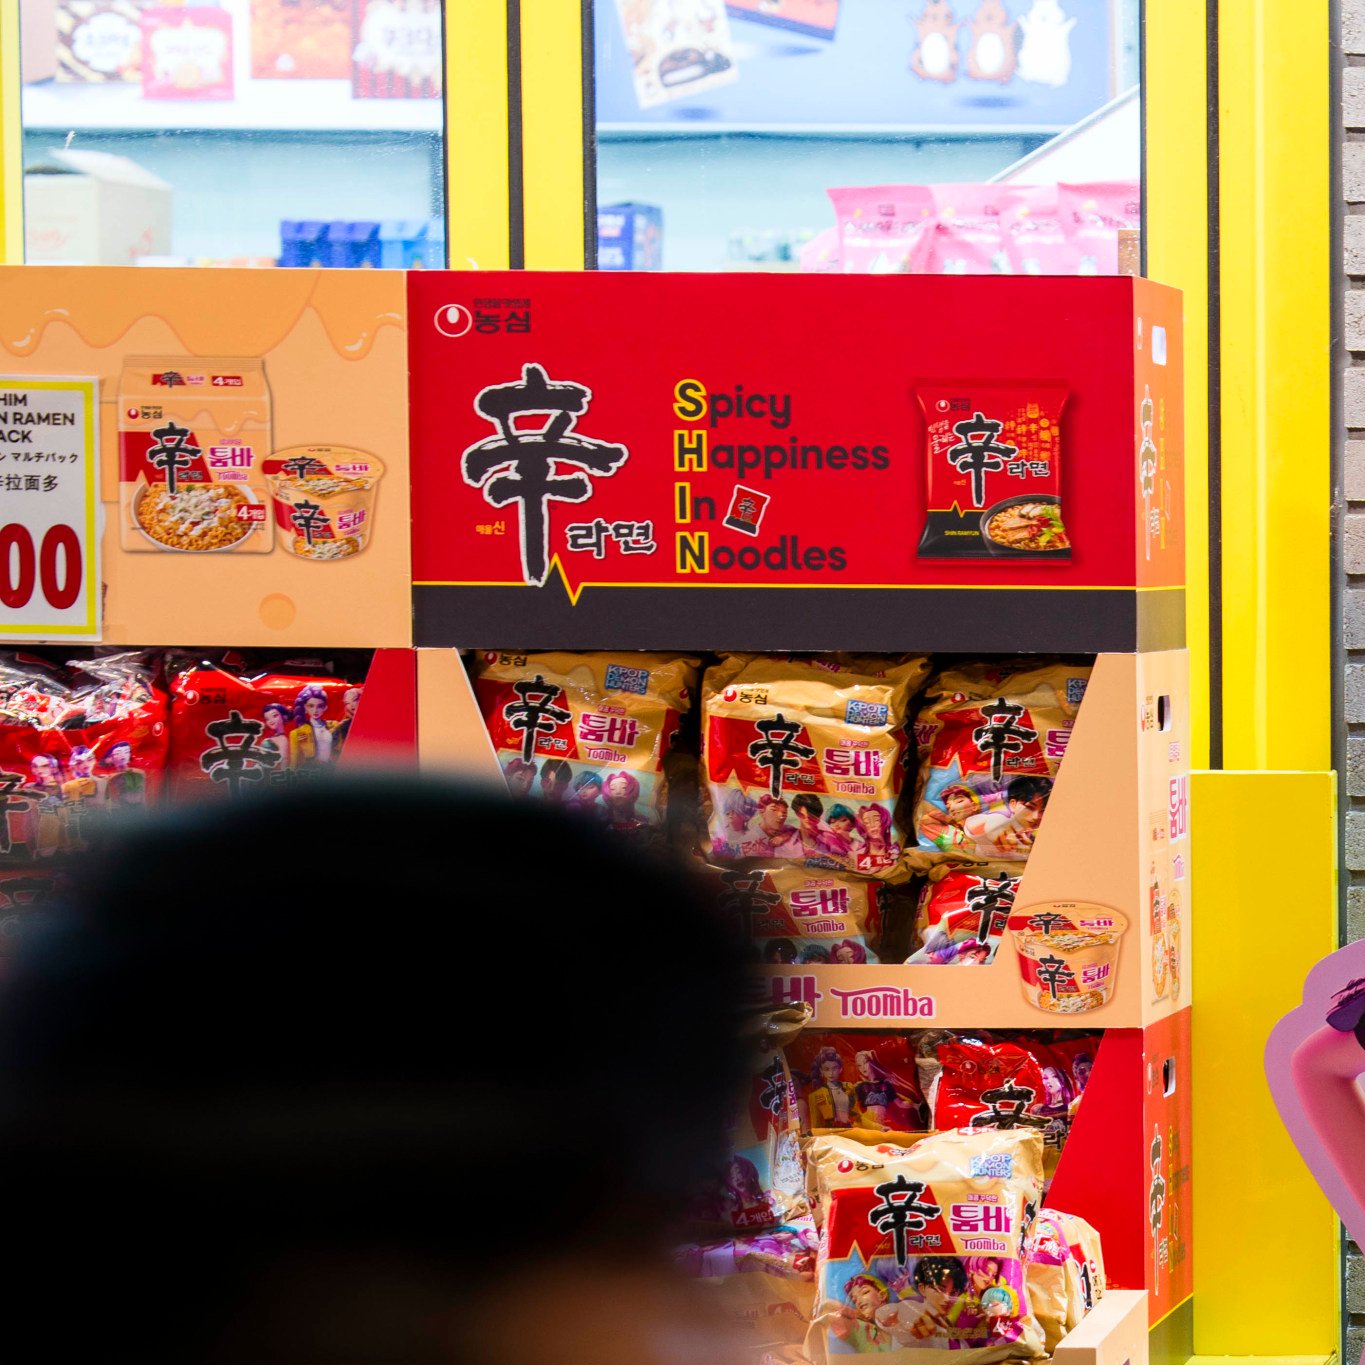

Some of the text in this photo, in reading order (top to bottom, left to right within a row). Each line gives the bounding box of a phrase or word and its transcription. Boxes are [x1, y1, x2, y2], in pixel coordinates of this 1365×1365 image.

[473, 310, 532, 334] 농심
[673, 378, 792, 429] Spicy
[13, 412, 75, 426] RAMEN
[11, 452, 79, 464] マルチパック
[147, 421, 202, 495] 辛
[208, 446, 254, 469] 툼바
[282, 456, 327, 480] 辛
[674, 430, 891, 480] Happiness
[947, 412, 1020, 508] 辛
[1008, 461, 1051, 479] 라면
[0, 473, 59, 492] 拉面多
[460, 362, 629, 587] 辛
[675, 481, 717, 524] In
[292, 499, 331, 546] 辛
[565, 518, 657, 559] 라면
[675, 531, 848, 574] Noodles
[499, 655, 528, 667] 농심
[608, 664, 649, 679] KPOP
[739, 691, 768, 705] 농심
[503, 675, 572, 765] 辛
[578, 712, 640, 747] 툼바
[585, 746, 628, 763] Toomba
[972, 697, 1038, 783] 辛
[748, 713, 816, 800] 辛
[823, 748, 886, 780] 툼바
[785, 772, 816, 785] 라면
[832, 780, 876, 795] Toomba
[790, 888, 851, 918] 툼바
[801, 919, 845, 934] Toomba
[1028, 912, 1073, 935] 辛
[1036, 954, 1076, 1000] 辛
[830, 985, 937, 1020] Toomba
[735, 1209, 774, 1227] 4개입
[868, 1174, 942, 1268] 辛
[950, 1204, 1012, 1234] 툼바
[909, 1234, 941, 1249] 라면
[960, 1237, 1007, 1251] Toomba
